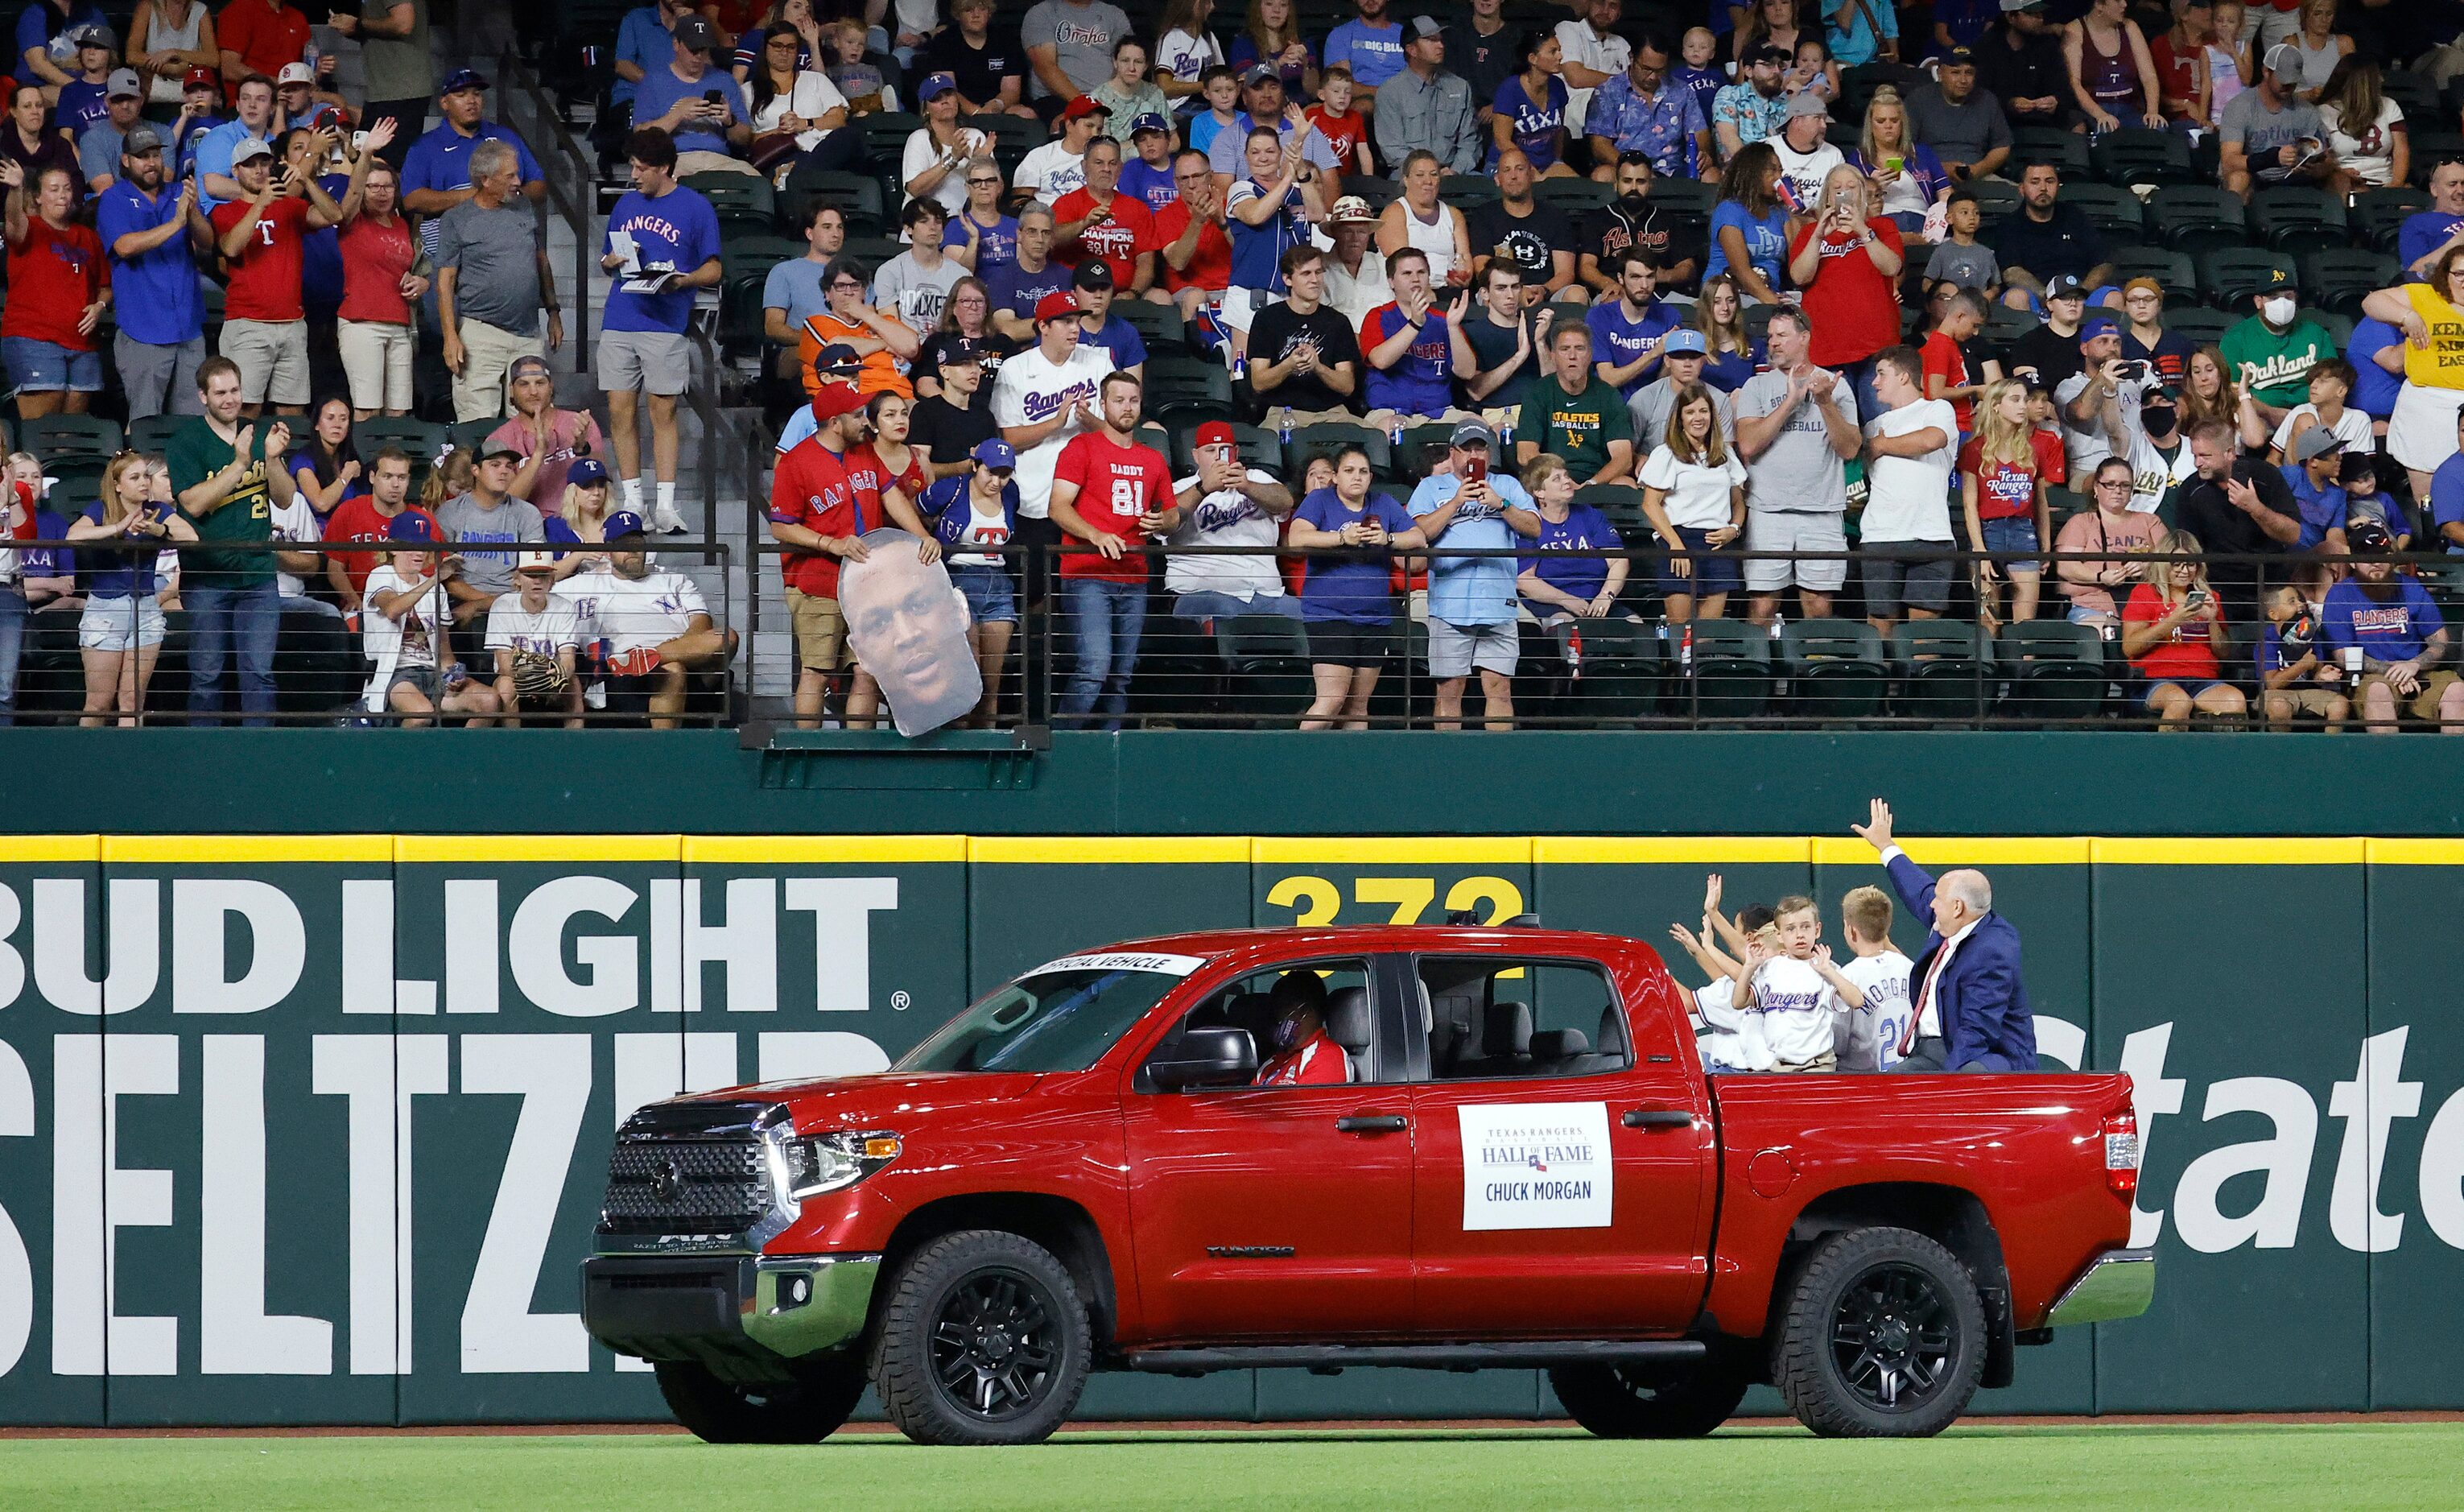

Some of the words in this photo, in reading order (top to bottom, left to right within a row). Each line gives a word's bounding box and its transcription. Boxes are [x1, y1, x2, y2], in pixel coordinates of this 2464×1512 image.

[695, 23, 705, 34] T
[1365, 40, 1382, 52] BIG
[1384, 42, 1404, 53] BLU
[1476, 47, 1488, 63] T
[930, 74, 940, 84] T
[1138, 114, 1149, 125] T
[1515, 109, 1563, 132] TEXA
[130, 198, 139, 208] T
[255, 219, 275, 246] T
[1079, 229, 1135, 244] HAMPIONS
[959, 338, 971, 351] T
[1682, 332, 1694, 345] T
[1434, 360, 1446, 376] T
[1779, 421, 1823, 433] ASEBALL
[997, 444, 1009, 456] T
[584, 461, 597, 471] T
[1109, 462, 1144, 477] DADDY
[1997, 469, 2029, 482] Texas
[809, 469, 878, 514] RANGER
[1986, 479, 2033, 495] Rangers
[1111, 479, 1144, 517] 21
[415, 519, 426, 533] T
[619, 513, 631, 526] T
[976, 527, 1009, 560] T
[2352, 607, 2409, 626] RANGERS
[0, 877, 306, 1014] UD
[341, 875, 898, 1018] LIGHT
[1098, 956, 1171, 969] VEHICLE
[1761, 984, 1820, 1012] Rangers
[1859, 974, 1910, 1018] MORGA
[1879, 1014, 1909, 1072] 21
[1488, 1129, 1526, 1138] TEXAS
[1530, 1127, 1583, 1136] RANGERS
[1482, 1146, 1529, 1163] HALL
[1530, 1146, 1542, 1155] OF
[1545, 1145, 1594, 1162] FAME
[1486, 1182, 1529, 1201] CHUCK
[1534, 1180, 1591, 1200] MORGAN
[0, 1034, 891, 1375] ELTZ
